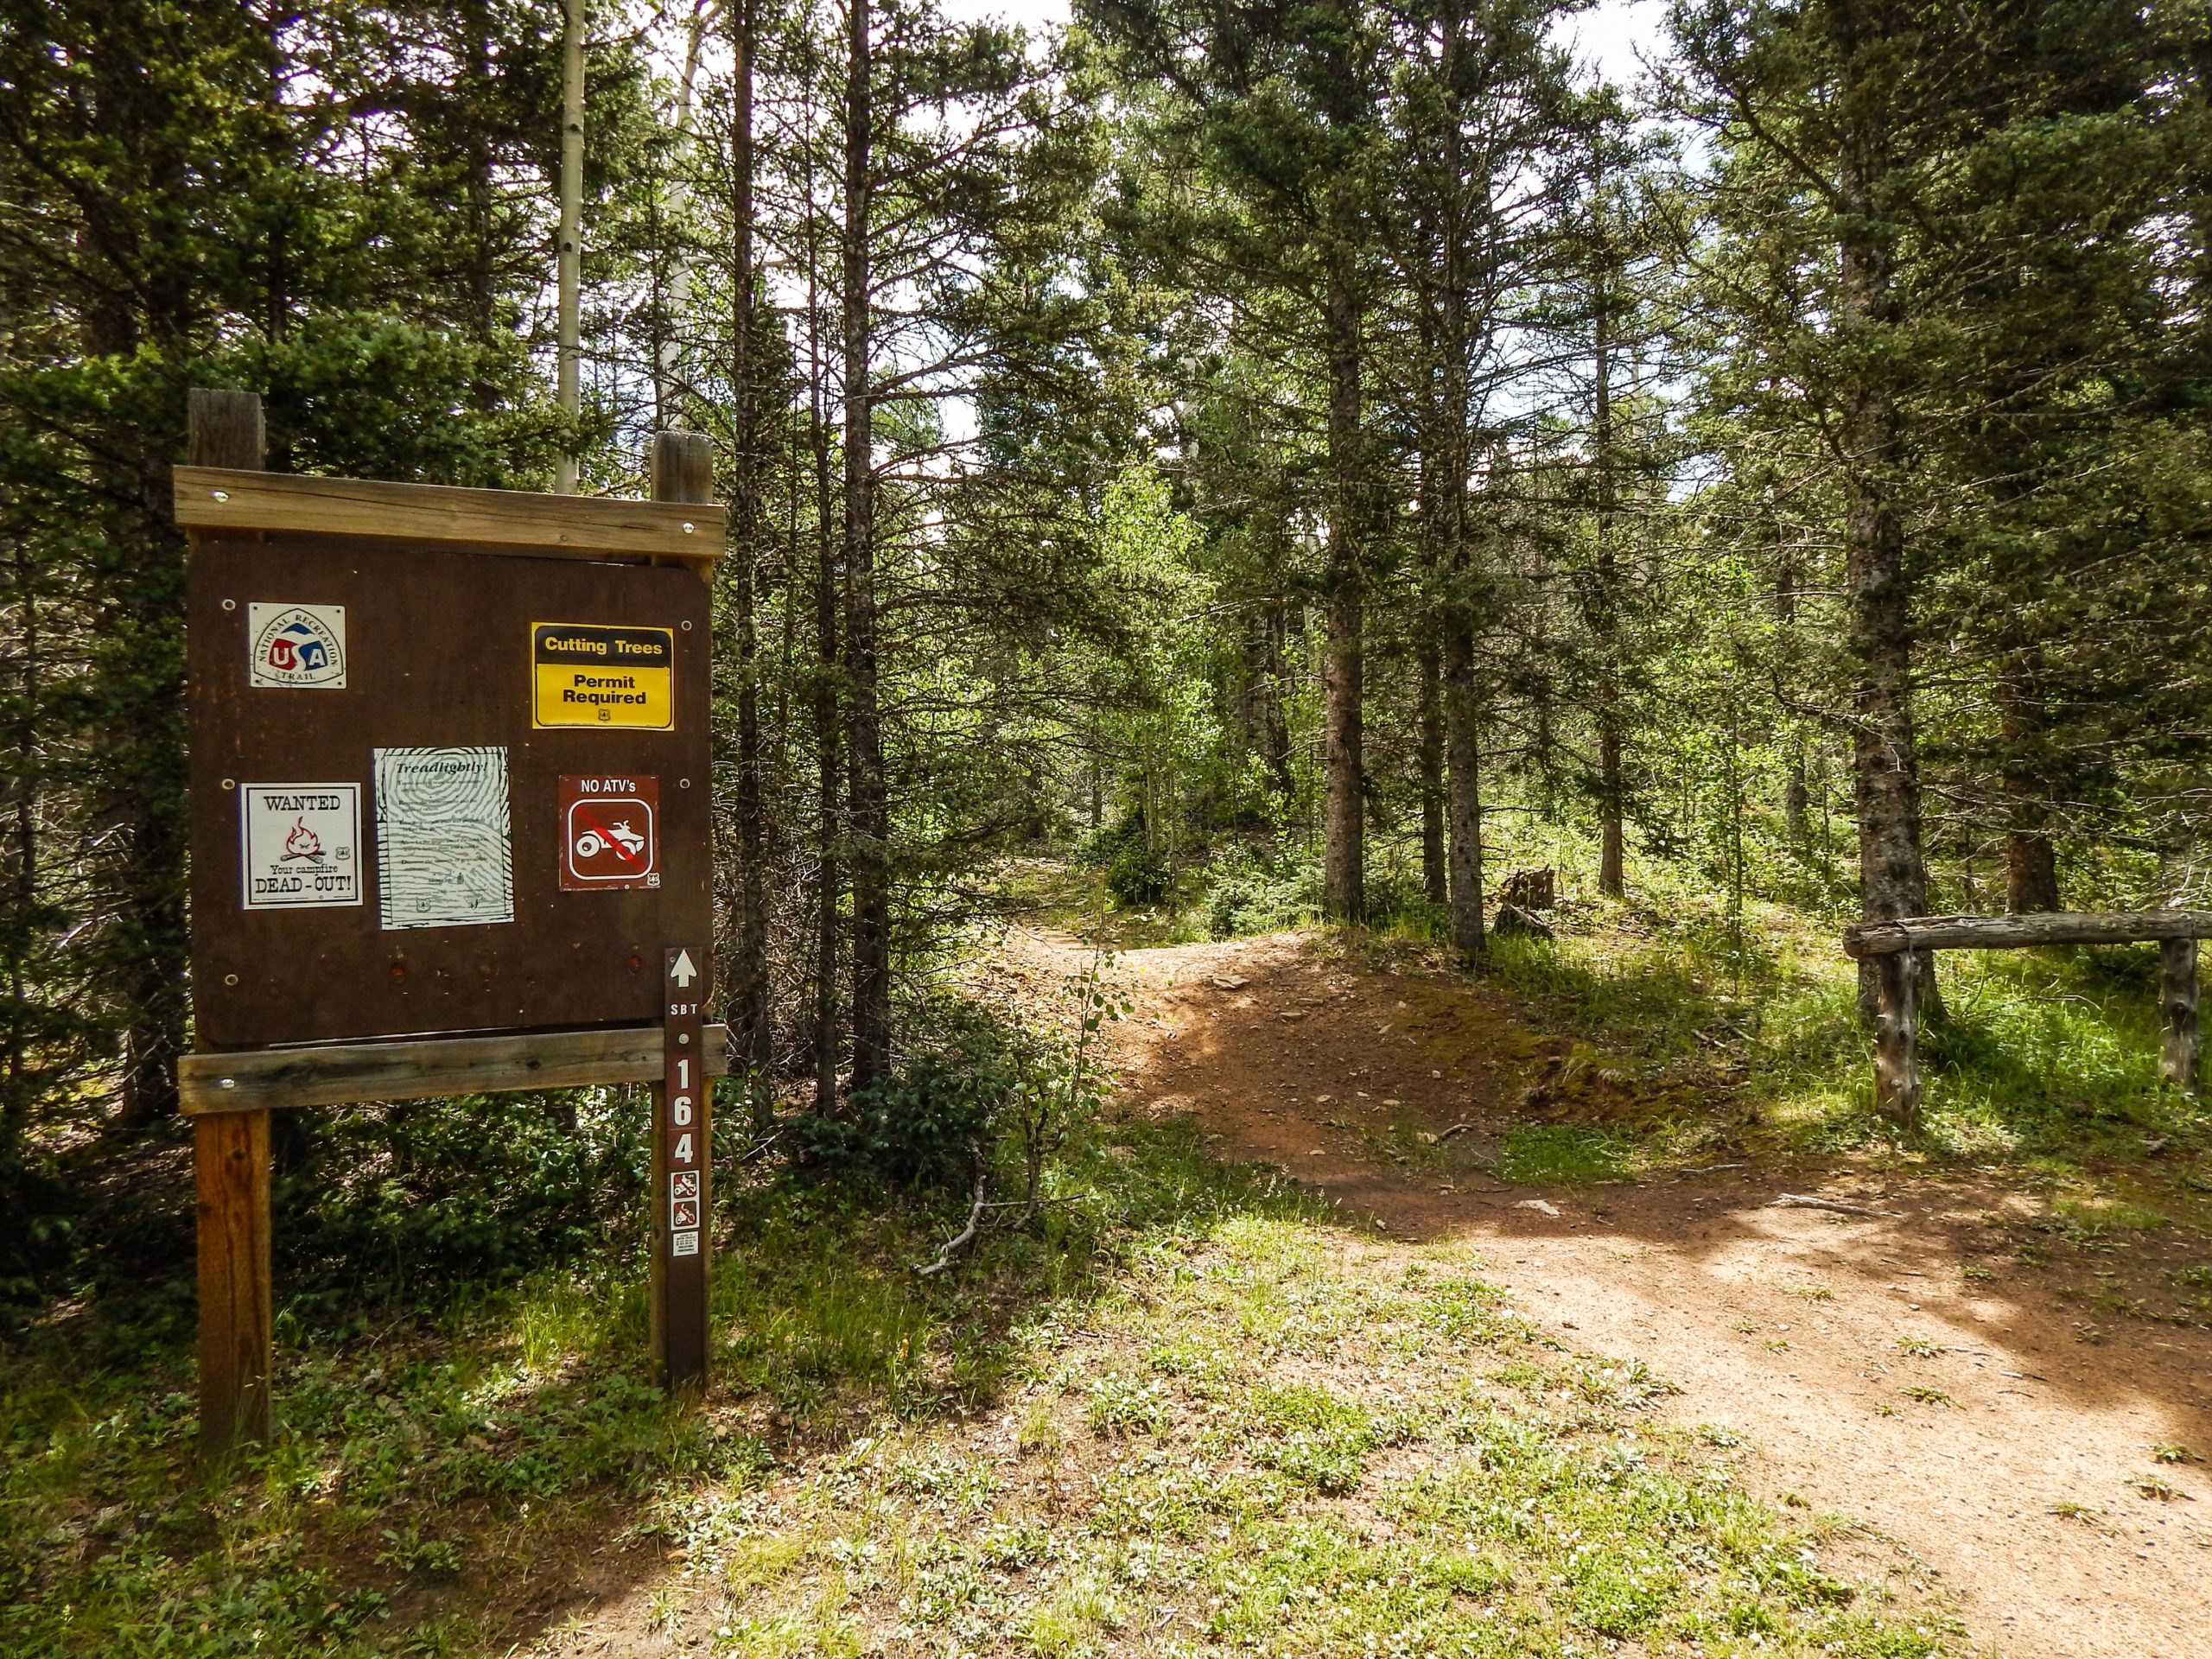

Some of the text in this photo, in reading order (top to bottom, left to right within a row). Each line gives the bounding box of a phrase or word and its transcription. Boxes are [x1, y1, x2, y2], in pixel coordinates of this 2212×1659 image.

[259, 614, 338, 665] NATIONAL RECREATION
[545, 637, 663, 655] Cutting Trees
[273, 645, 326, 669] USA
[574, 674, 635, 689] Permit
[563, 690, 646, 705] Required
[581, 779, 636, 792] NO ATV's
[264, 795, 340, 810] WANTED
[270, 864, 338, 876] Your campfire
[671, 1003, 697, 1015] SBT
